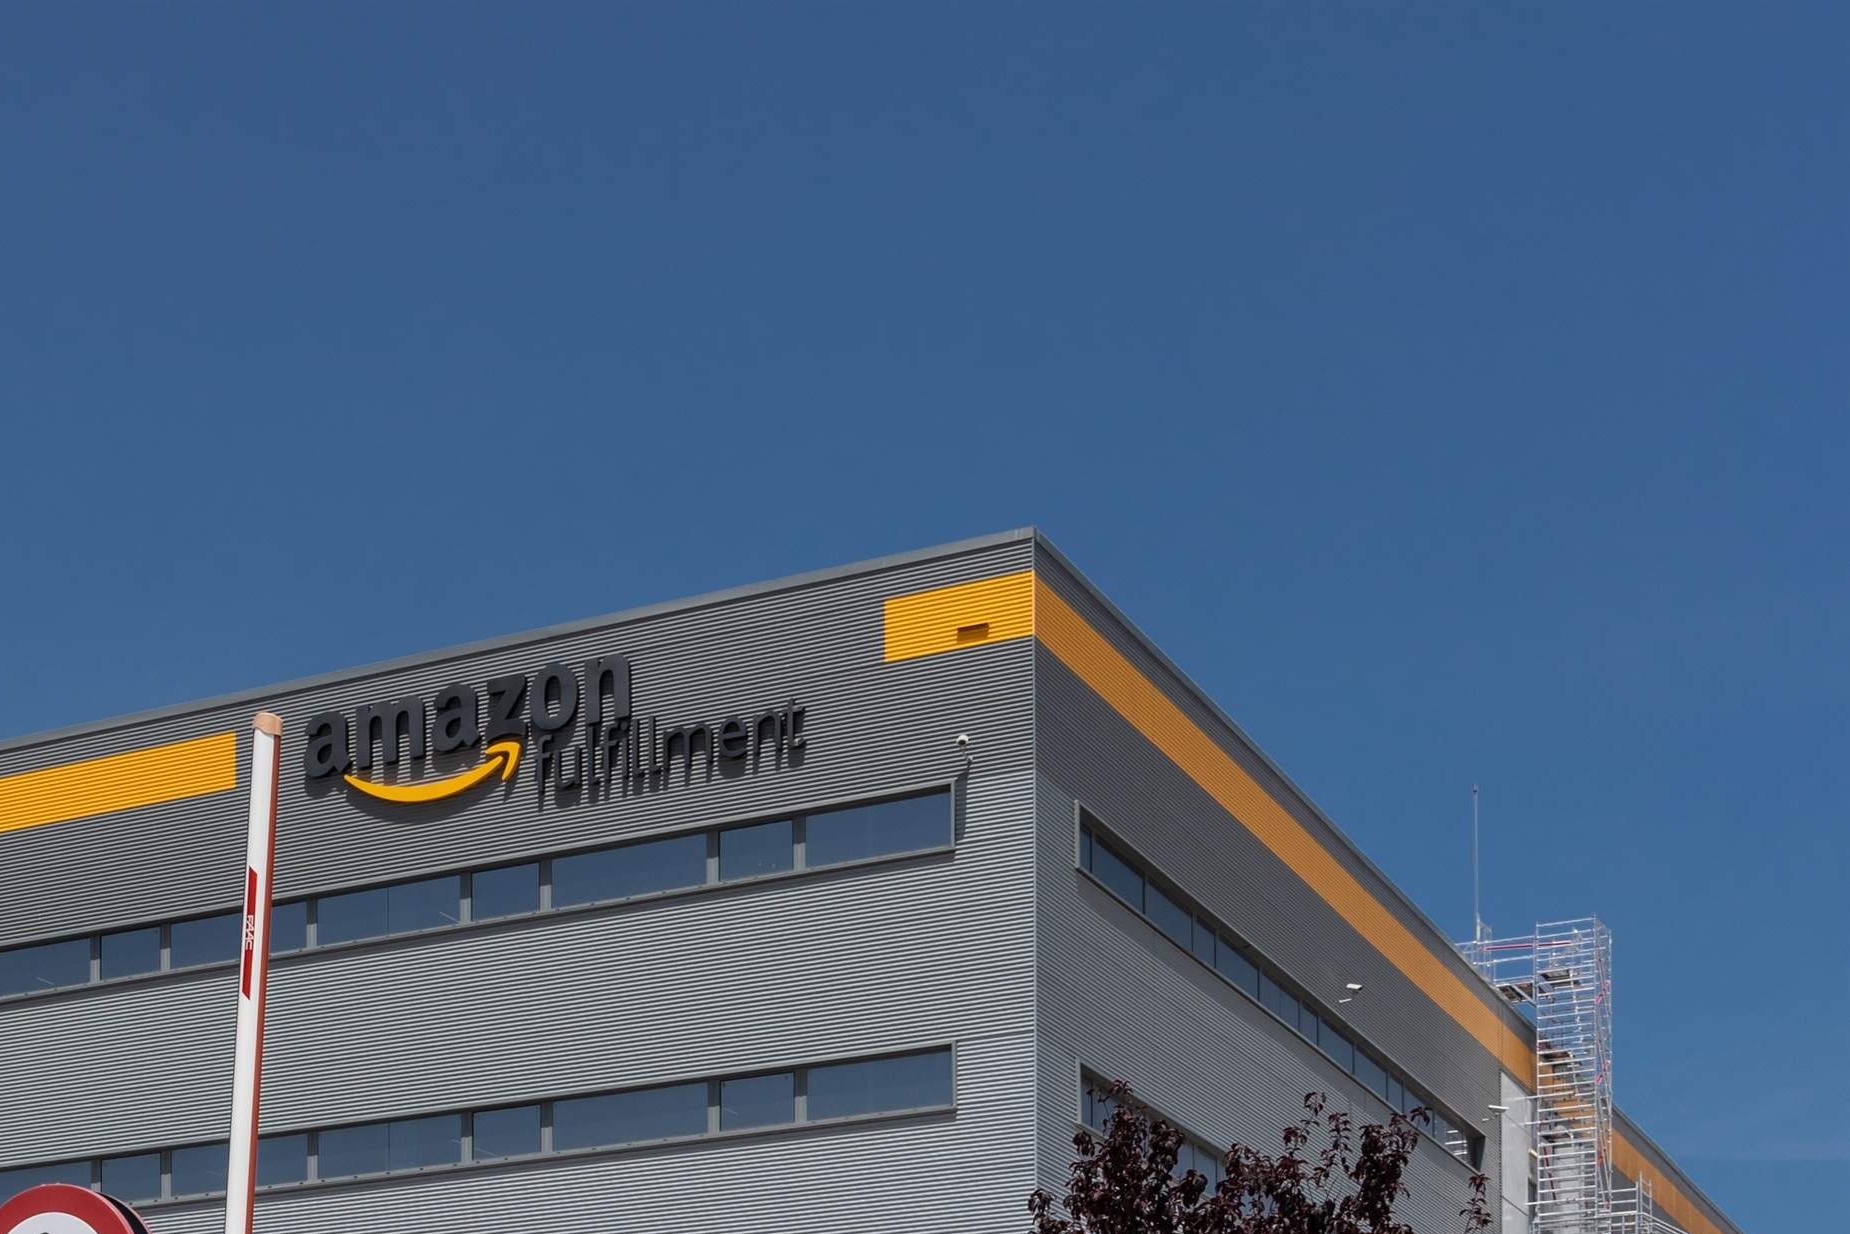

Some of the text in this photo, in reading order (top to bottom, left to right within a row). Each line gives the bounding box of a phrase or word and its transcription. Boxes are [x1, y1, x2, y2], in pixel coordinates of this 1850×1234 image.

[304, 653, 631, 780] amazon
[536, 697, 806, 792] fulfillment
[246, 914, 254, 951] FAAC
